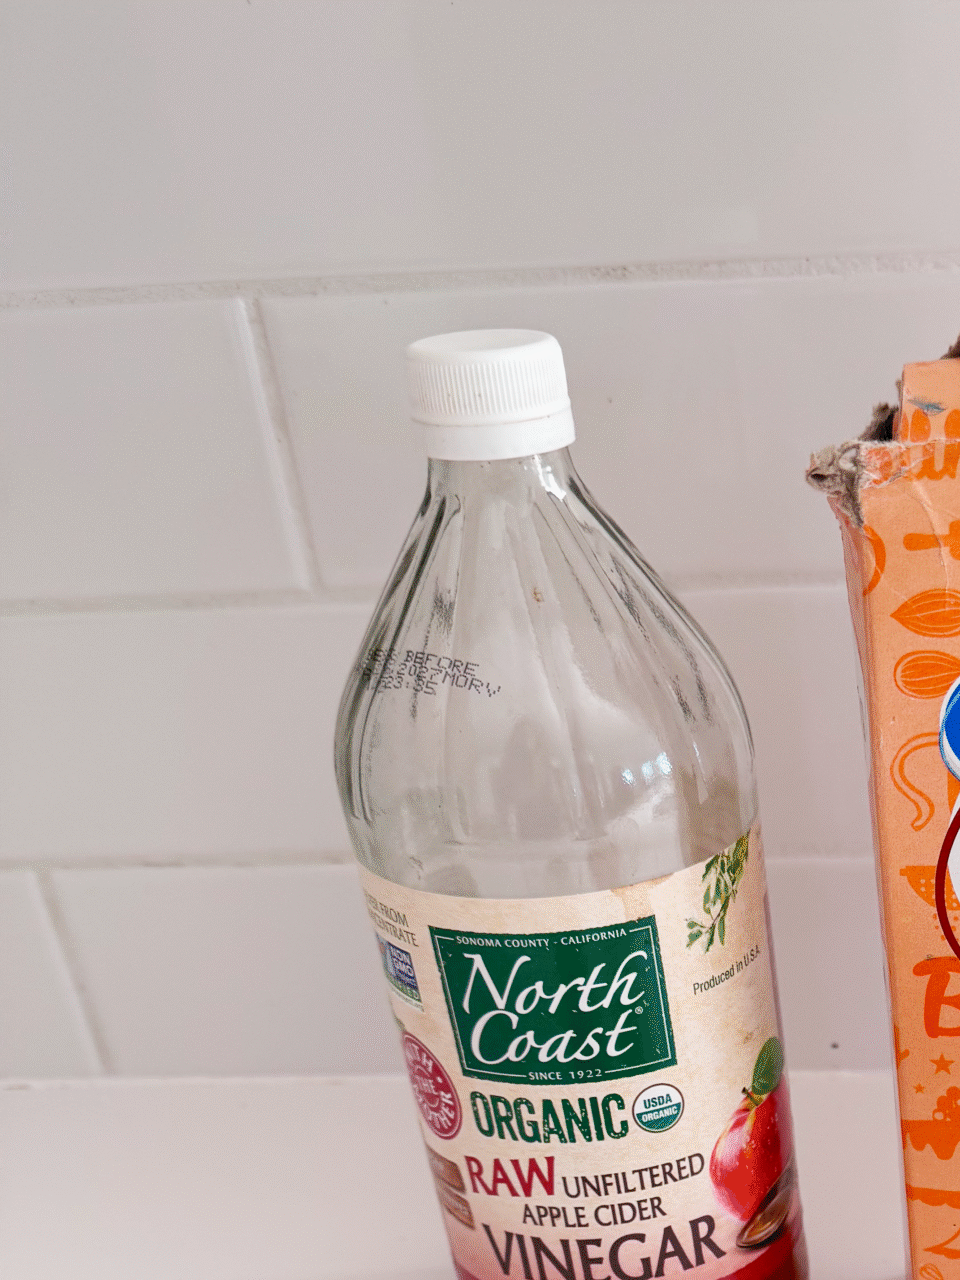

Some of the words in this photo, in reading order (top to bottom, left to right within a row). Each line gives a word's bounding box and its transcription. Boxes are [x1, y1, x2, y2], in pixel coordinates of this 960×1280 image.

[456, 936, 502, 948] SONOMA
[504, 938, 550, 948] COUNTY
[560, 928, 627, 945] CALIFORNIA
[462, 950, 648, 1014] North
[693, 964, 735, 995] Produced
[736, 961, 744, 973] in
[471, 1009, 638, 1065] Coast
[528, 1071, 563, 1081] SINCE
[570, 1069, 602, 1079] 1922
[470, 1091, 629, 1143] ORGANIC
[642, 1106, 678, 1122] ORGANIC
[643, 1094, 672, 1109] USDA
[464, 1156, 555, 1198] RAW
[561, 1153, 705, 1198] UNFILTERED
[522, 1203, 589, 1228] APPLE
[594, 1196, 667, 1226] CIDER
